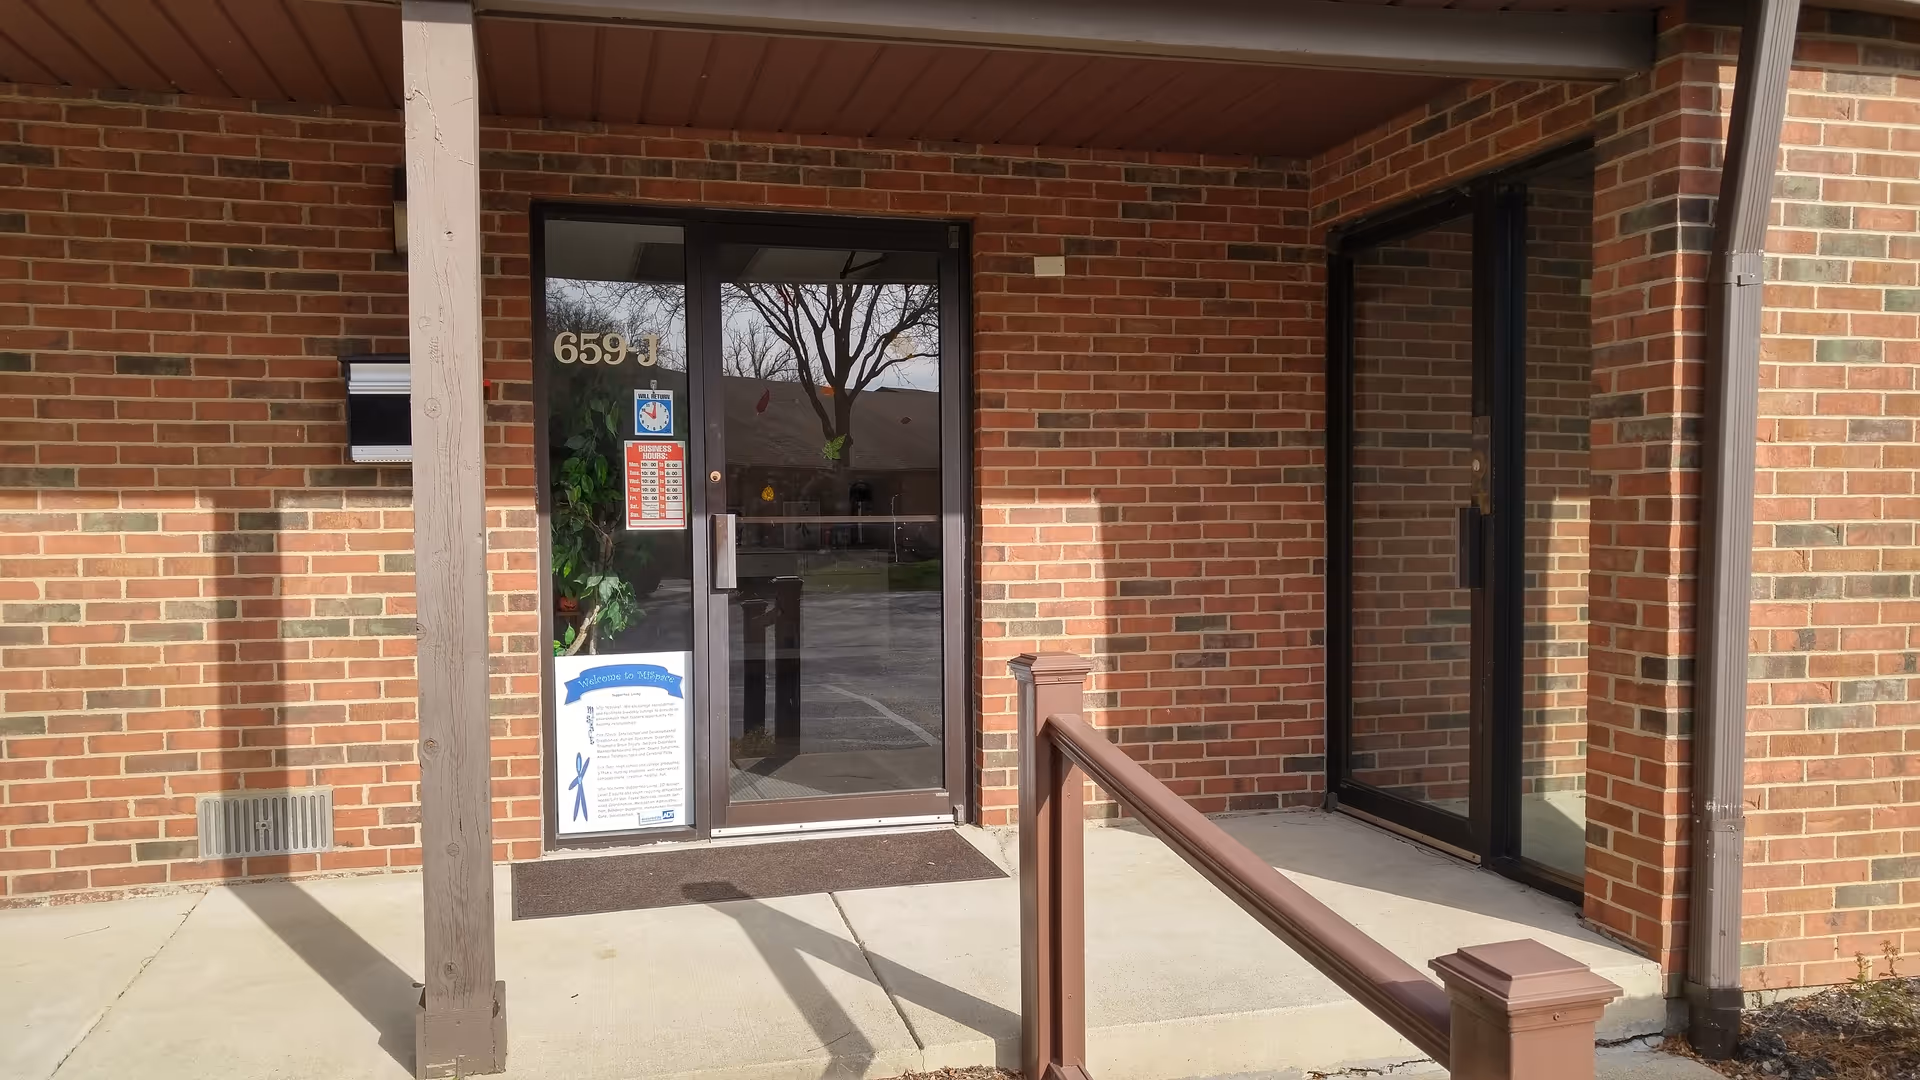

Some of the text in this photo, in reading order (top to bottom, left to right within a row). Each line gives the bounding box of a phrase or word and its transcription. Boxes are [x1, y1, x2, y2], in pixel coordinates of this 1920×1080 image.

[554, 331, 660, 367] 659-J
[578, 673, 621, 688] Welcome
[624, 671, 634, 680] to
